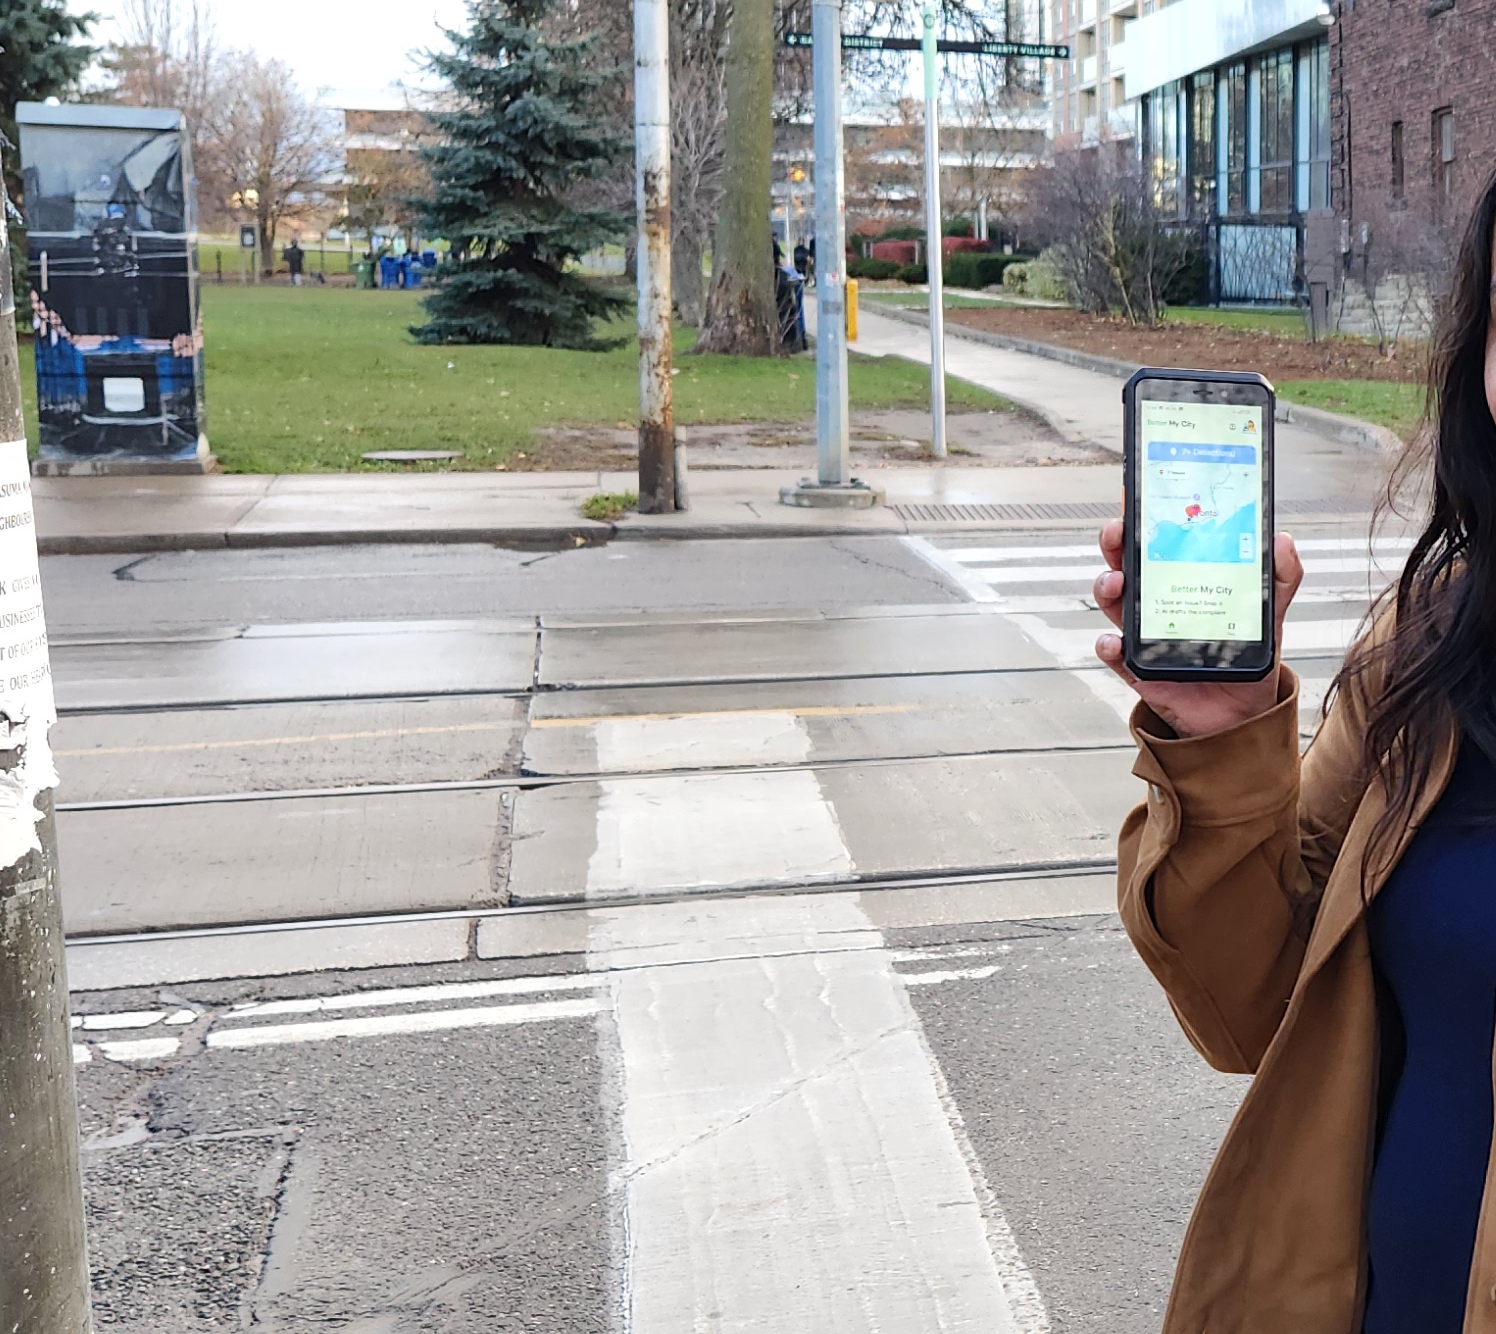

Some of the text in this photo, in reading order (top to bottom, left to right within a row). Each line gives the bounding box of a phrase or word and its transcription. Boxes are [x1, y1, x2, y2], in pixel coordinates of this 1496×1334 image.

[843, 39, 883, 48] DISTRICT
[984, 43, 1055, 56] LIBERTY VILLAGE
[1169, 419, 1179, 428] My
[1181, 420, 1196, 429] City
[1171, 584, 1233, 596] Better My City
[8, 644, 19, 658] OF
[9, 674, 29, 690] OUR
